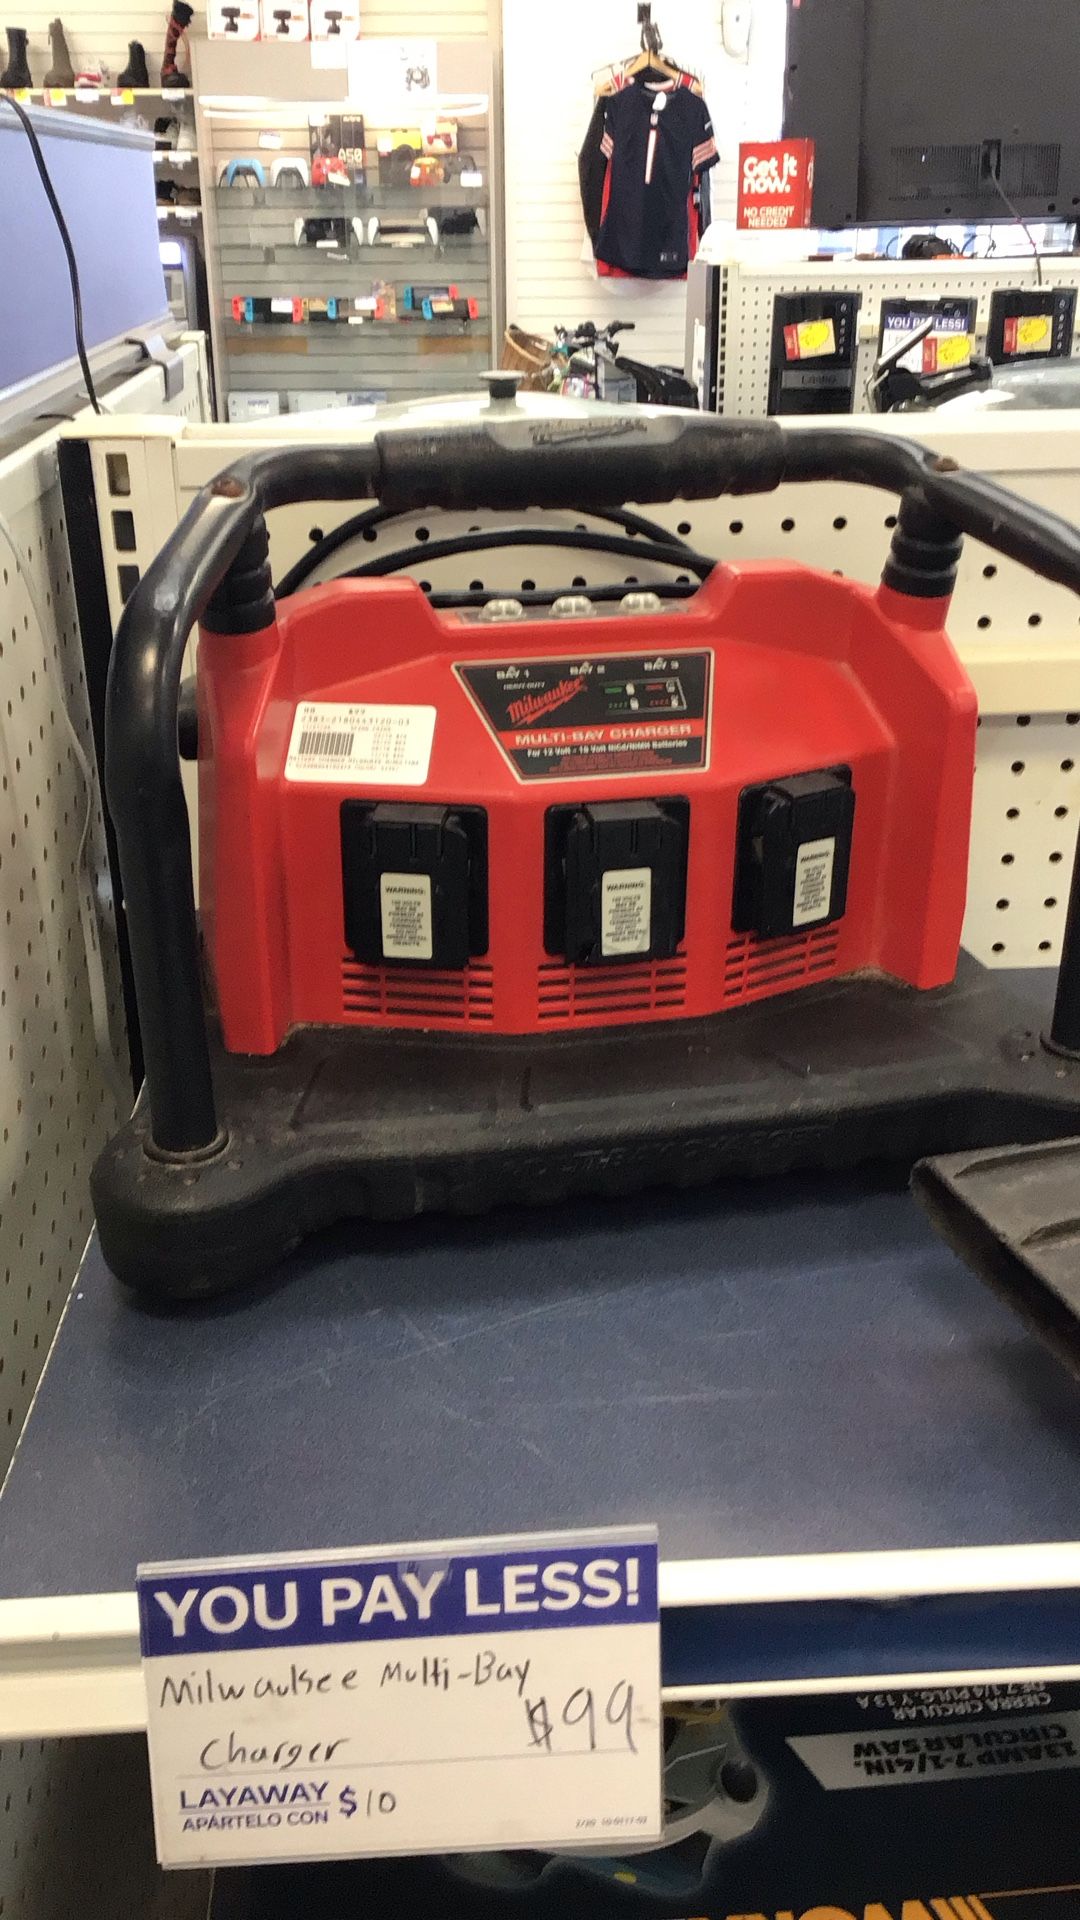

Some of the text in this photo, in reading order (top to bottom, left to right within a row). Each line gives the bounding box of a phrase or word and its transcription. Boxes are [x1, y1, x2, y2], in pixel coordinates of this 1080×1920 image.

[743, 156, 779, 178] Get
[783, 152, 798, 177] it
[743, 175, 791, 194] now.
[743, 207, 758, 218] NO
[760, 205, 794, 217] CREDIT
[748, 216, 788, 228] NEEDED
[887, 316, 910, 329] YOU
[935, 317, 965, 329] LESS!
[569, 661, 594, 676] BAY
[643, 657, 667, 671] BAY
[496, 665, 520, 680] BAY
[515, 723, 692, 746] MULTI-BAY CHARGER
[153, 1557, 639, 1638] YOU PAY LESS!
[857, 1696, 869, 1709] A
[874, 1695, 895, 1708] 13
[902, 1694, 913, 1706] Y
[893, 1700, 983, 1720] CIRCULAR
[853, 1723, 1067, 1758] CIRCULAR SAW
[200, 1731, 350, 1771] Charger
[180, 1781, 329, 1810] LAYAWAY
[286, 1810, 329, 1825] CON
